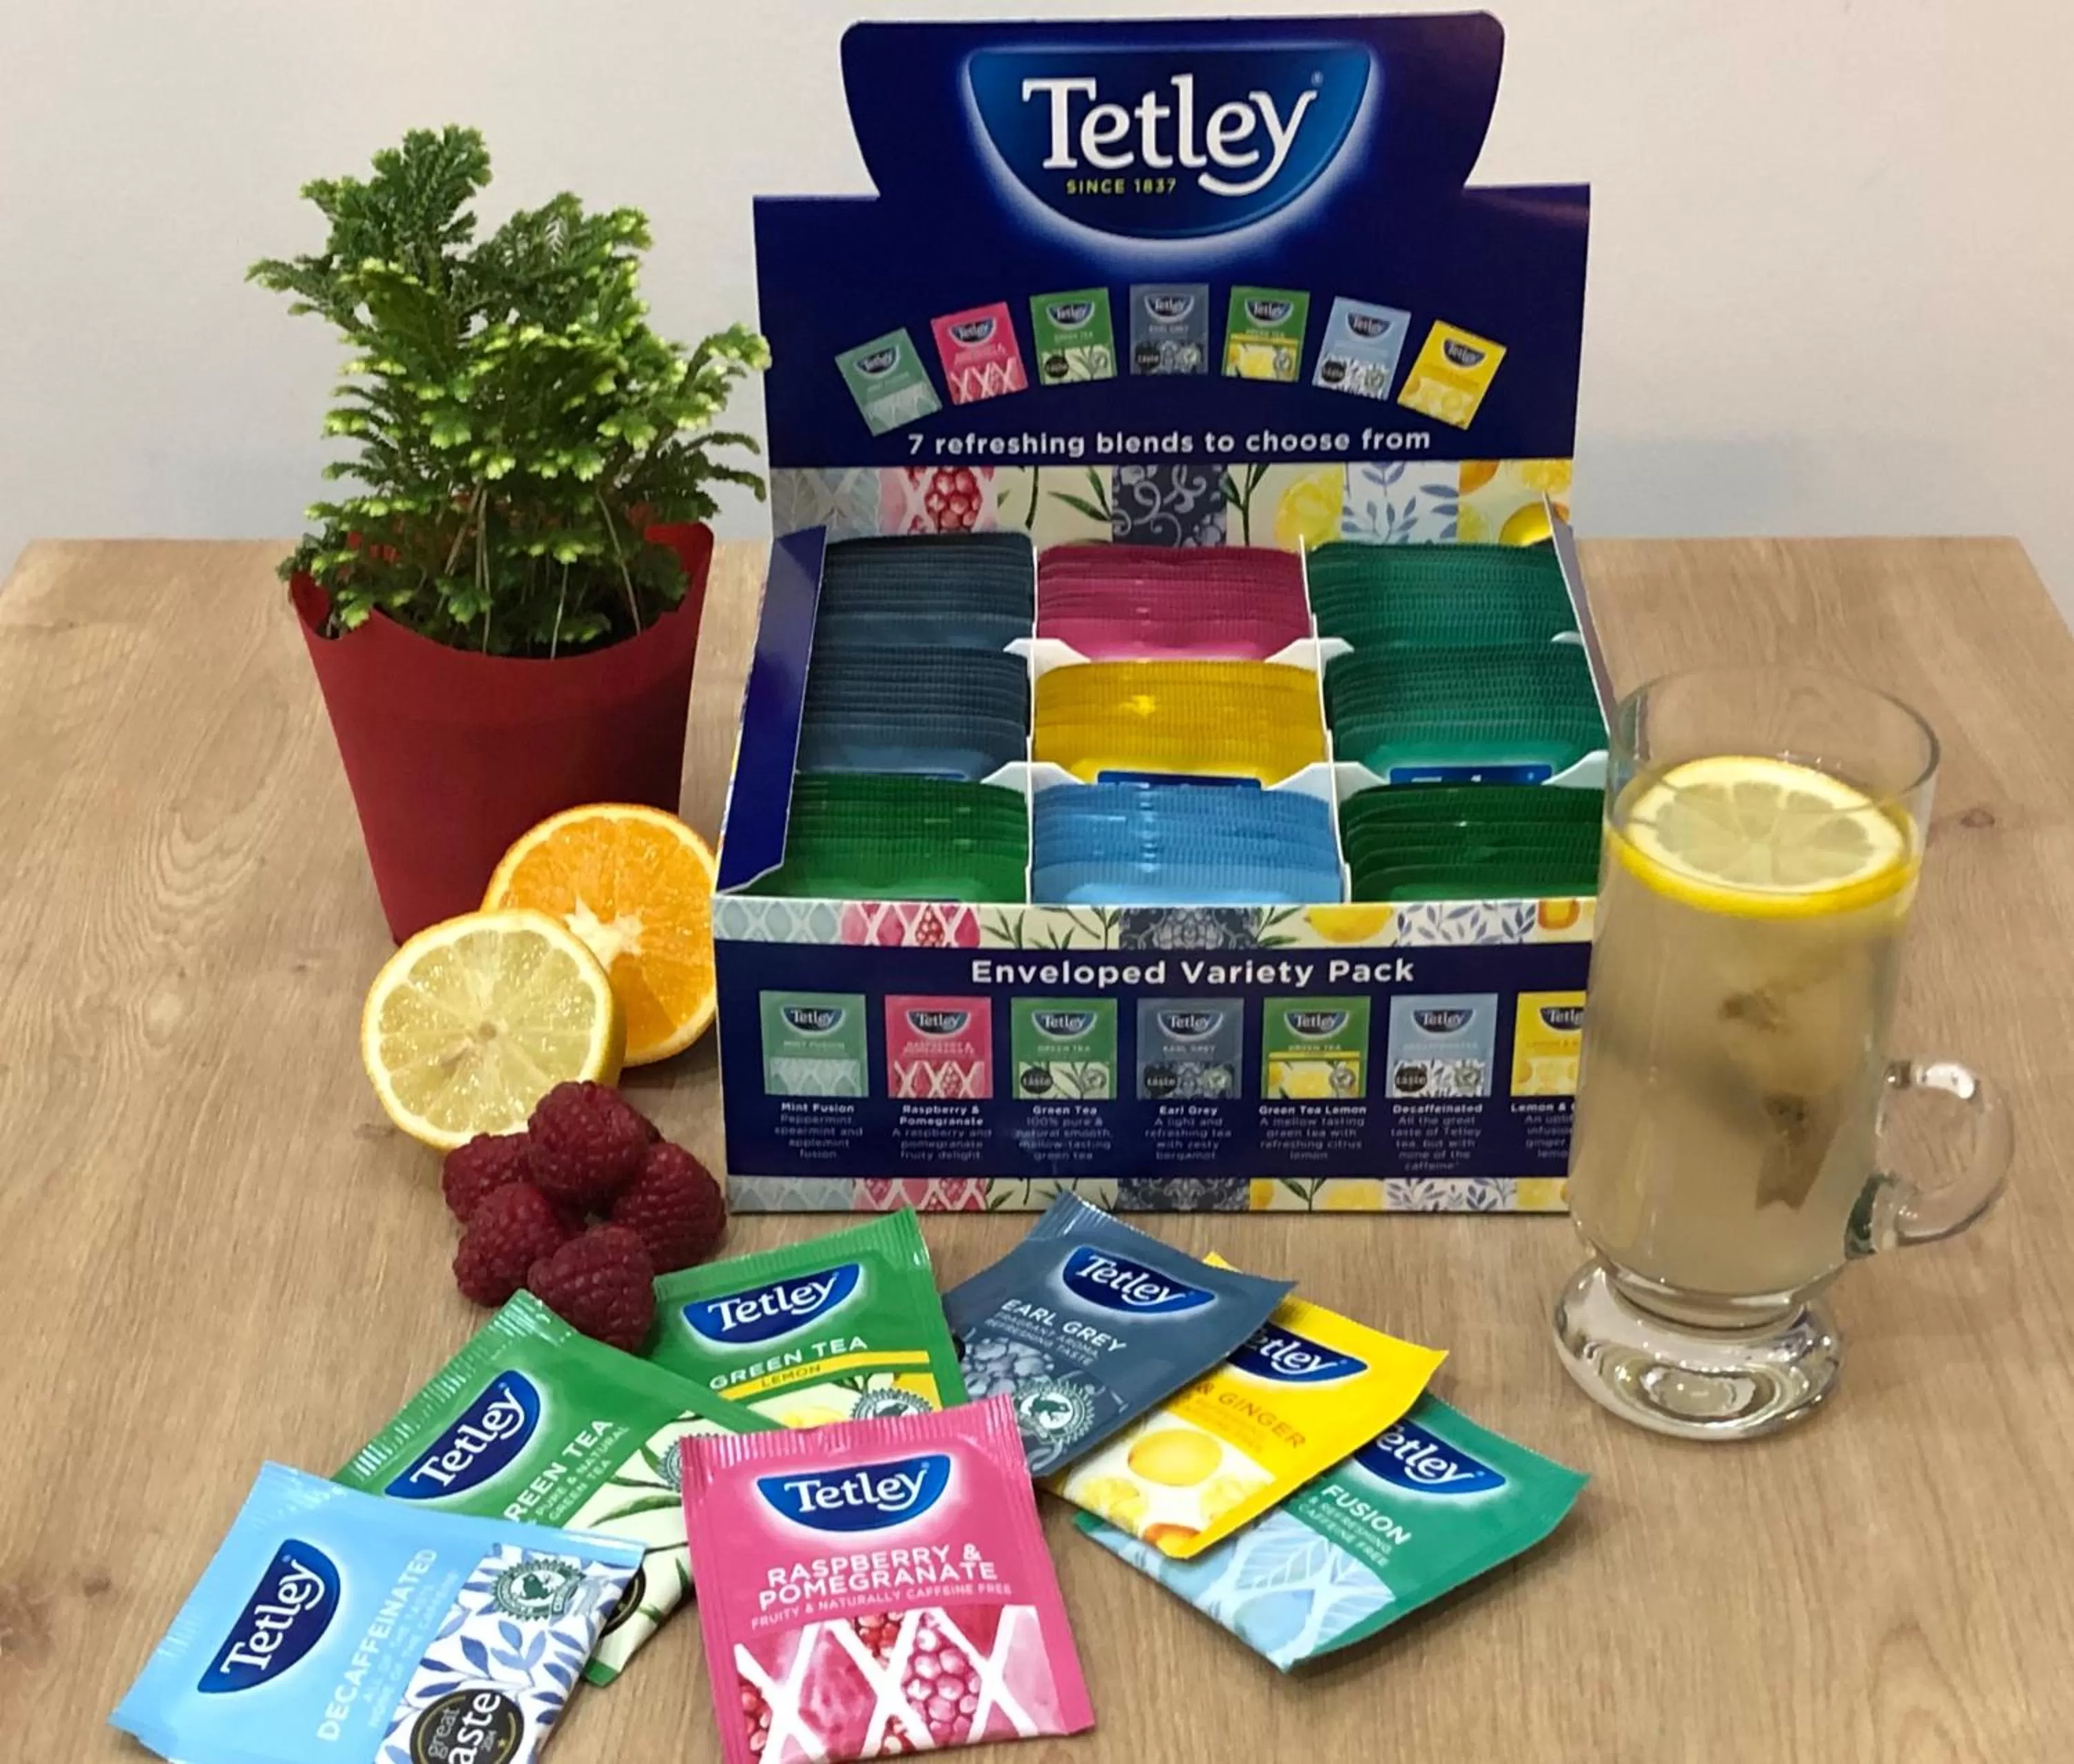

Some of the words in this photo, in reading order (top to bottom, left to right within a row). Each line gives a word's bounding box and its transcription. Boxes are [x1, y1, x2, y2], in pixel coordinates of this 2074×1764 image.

[1022, 73, 1318, 197] Tetley
[1066, 178, 1125, 195] SINCE
[1134, 177, 1176, 194] 1837
[908, 433, 924, 456] 7
[935, 431, 1085, 458] refreshing
[1096, 430, 1193, 455] blends
[1204, 431, 1235, 453] to
[1246, 429, 1350, 453] choose
[1361, 427, 1430, 450] from
[971, 959, 1166, 988] Enveloped
[1181, 959, 1314, 987] Variety
[1328, 957, 1415, 983] Pack
[791, 1009, 835, 1028] Tetley
[917, 1012, 960, 1031] Tetley
[1041, 1014, 1085, 1031] Tetley
[1168, 1014, 1212, 1031] Tetley
[1294, 1013, 1338, 1031] Tetley
[1421, 1011, 1465, 1029] Tetley
[781, 1102, 808, 1113] Mint
[812, 1102, 855, 1114] Fusion
[899, 1116, 984, 1127] Pomegranate
[901, 1105, 967, 1116] Raspberry
[1032, 1105, 1070, 1116] Green
[1074, 1105, 1098, 1116] Tea
[1159, 1105, 1184, 1116] Earl
[1188, 1105, 1218, 1116] Grey
[1258, 1105, 1296, 1116] Green
[1300, 1105, 1322, 1116] Tea
[1325, 1105, 1367, 1116] Lemon
[1392, 1102, 1483, 1114] Decaffeinated
[1510, 1102, 1554, 1113] Lemon
[1558, 1102, 1567, 1112] &
[1537, 1150, 1569, 1159] lemo
[1076, 1253, 1188, 1306] Tetley
[708, 1276, 839, 1333] Tetley
[1001, 1298, 1057, 1326] EARL
[1062, 1320, 1128, 1352] GREY
[709, 1349, 803, 1390] GREEN
[811, 1335, 868, 1357] TEA
[760, 1364, 821, 1389] LEMON
[1217, 1392, 1307, 1449] GINGER
[410, 1387, 527, 1488] Tetley
[1375, 1425, 1476, 1484] etley
[503, 1461, 568, 1523] REEN
[561, 1420, 614, 1458] TEA
[784, 1469, 928, 1512] Tetley
[1320, 1484, 1412, 1546] FUSION
[767, 1544, 951, 1588] RASPBERRY
[962, 1543, 982, 1562] &
[758, 1561, 998, 1613] POMEGRANATE
[221, 1558, 326, 1675] Tetley
[751, 1606, 801, 1631] FRUITY
[805, 1602, 814, 1615] &
[818, 1591, 901, 1611] NATURALLY
[906, 1584, 973, 1600] CAFFEINE
[978, 1582, 1012, 1597] FREE
[316, 1548, 438, 1742] DECAFFEINATED
[427, 1708, 460, 1760] great
[448, 1692, 501, 1764] aste
